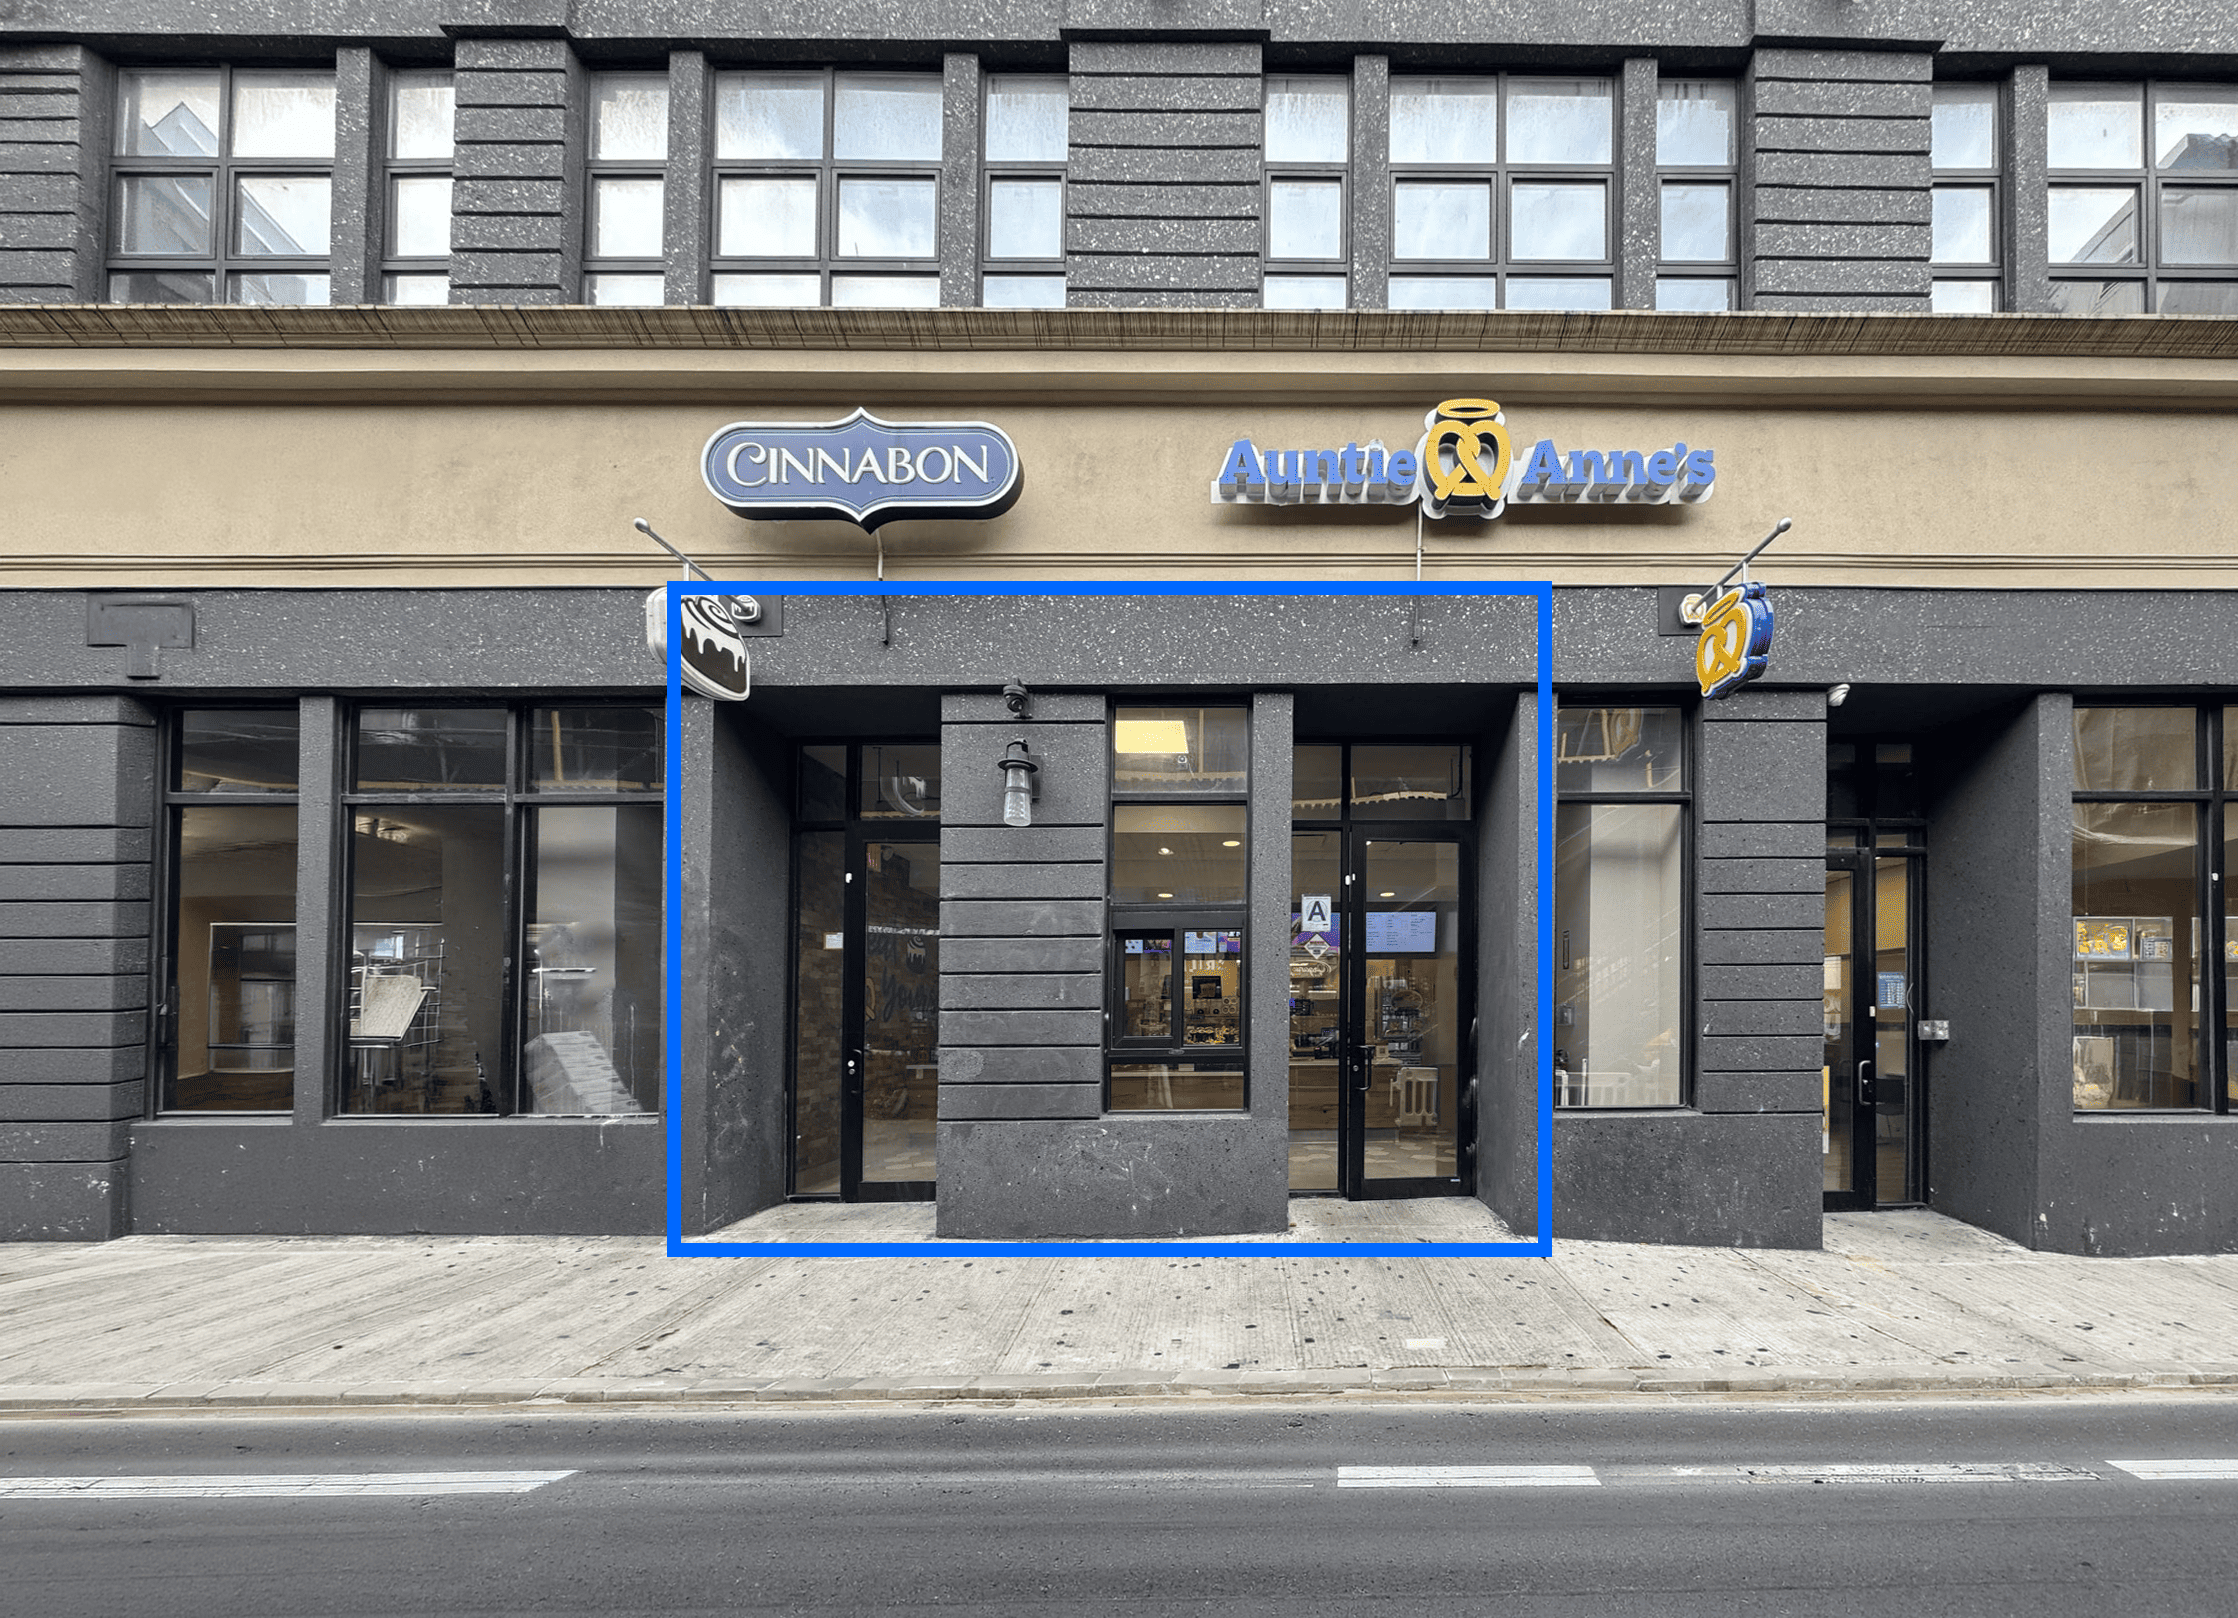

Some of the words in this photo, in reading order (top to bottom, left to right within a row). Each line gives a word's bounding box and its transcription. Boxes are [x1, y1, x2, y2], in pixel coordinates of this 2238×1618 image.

[726, 442, 990, 487] CINNABON
[1218, 438, 1419, 487] Auntie
[1520, 438, 1717, 487] Anne's
[1307, 900, 1327, 921] A
